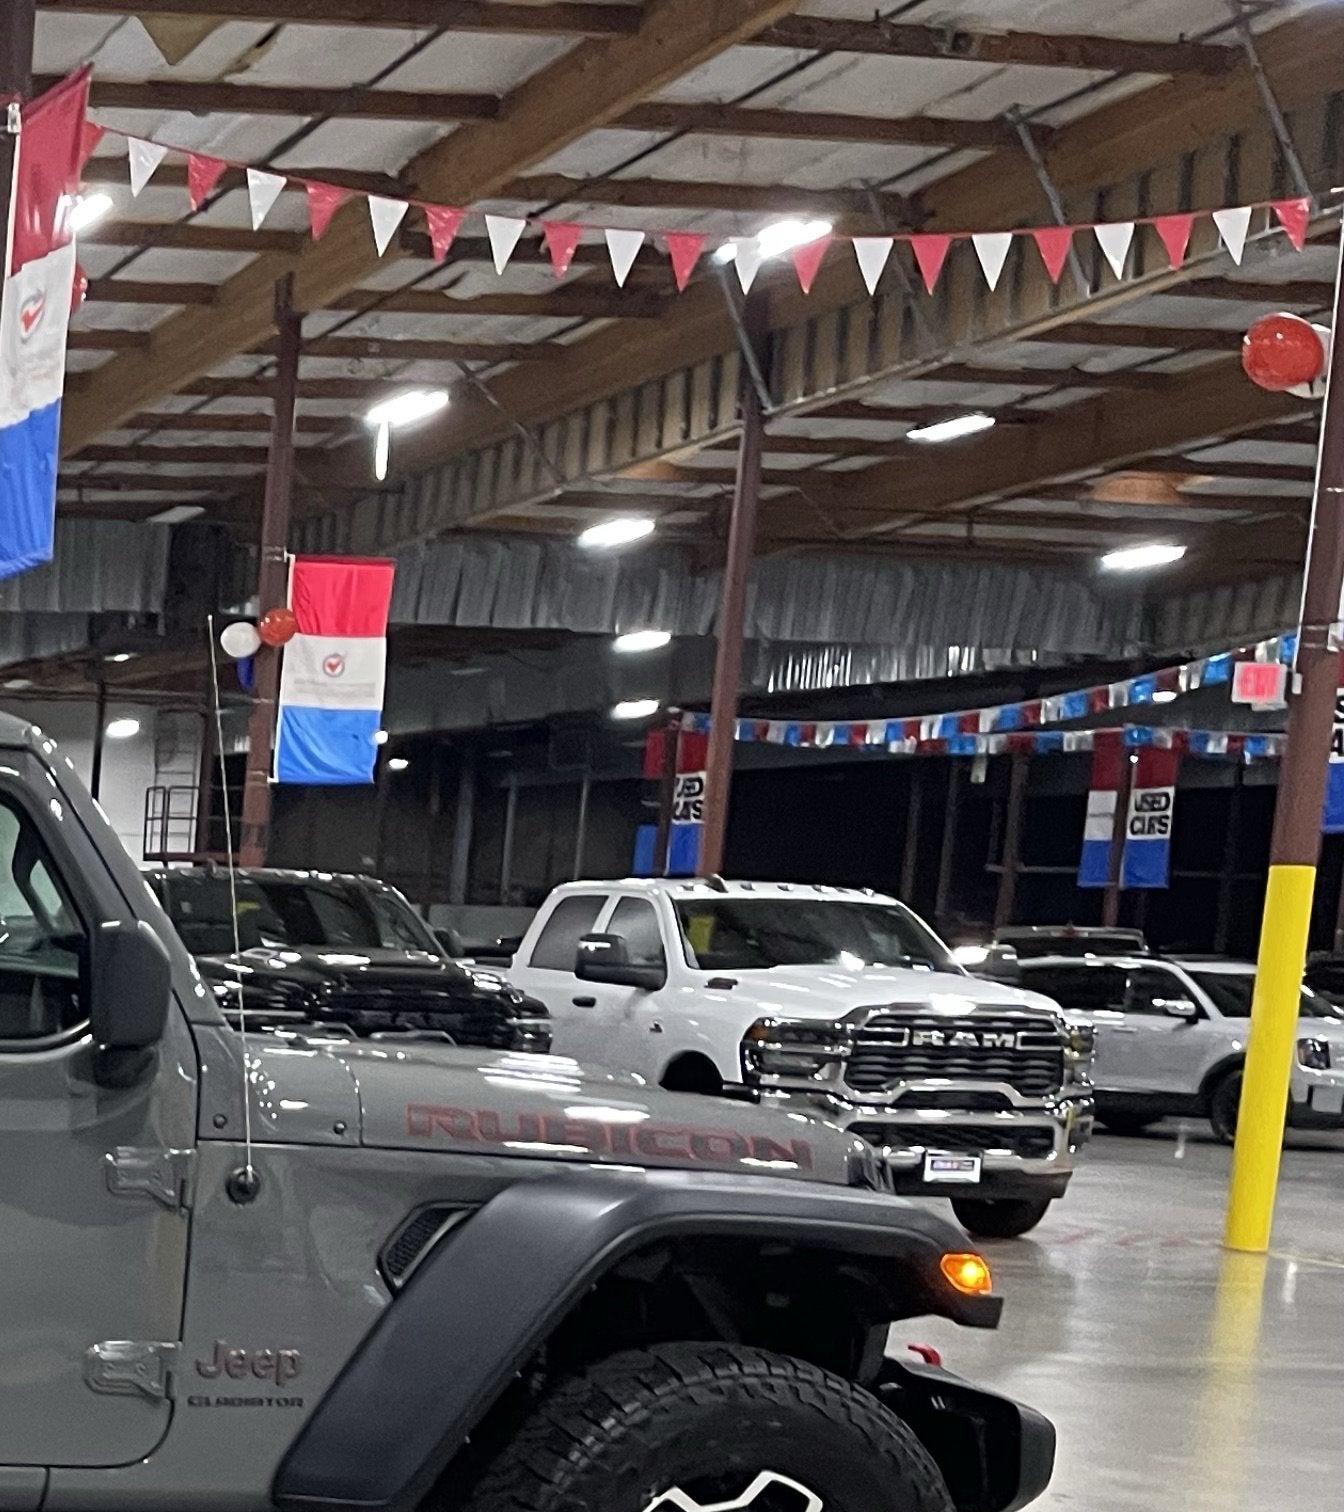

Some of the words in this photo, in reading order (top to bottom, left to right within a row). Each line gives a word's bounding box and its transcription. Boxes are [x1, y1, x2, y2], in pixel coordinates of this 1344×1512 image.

[912, 1030, 1016, 1047] RAM
[405, 1103, 813, 1169] RUBICON
[195, 1340, 301, 1388] Jeep
[187, 1395, 304, 1407] GLADIATOR
